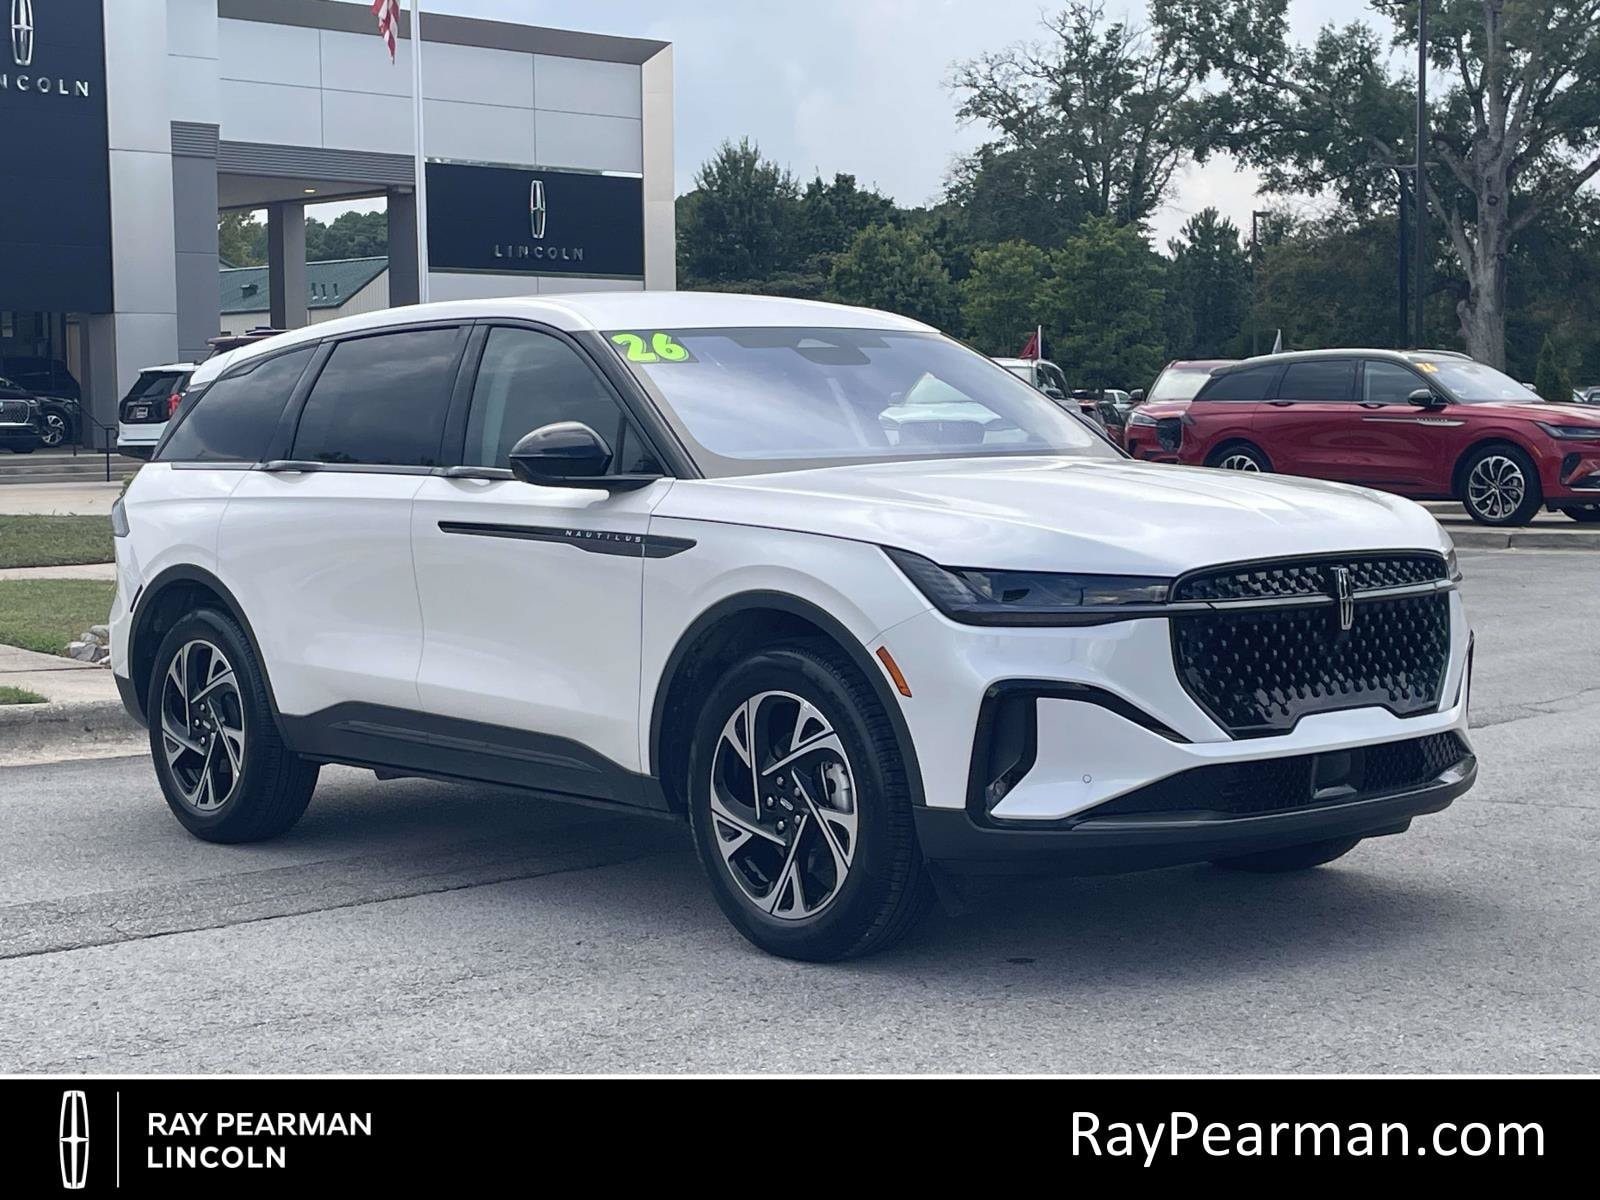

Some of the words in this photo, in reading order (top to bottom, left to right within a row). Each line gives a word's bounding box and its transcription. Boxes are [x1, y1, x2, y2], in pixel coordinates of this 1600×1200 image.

[495, 244, 584, 261] LINCOLN
[611, 333, 690, 363] 26
[565, 530, 641, 543] NAUTILUS
